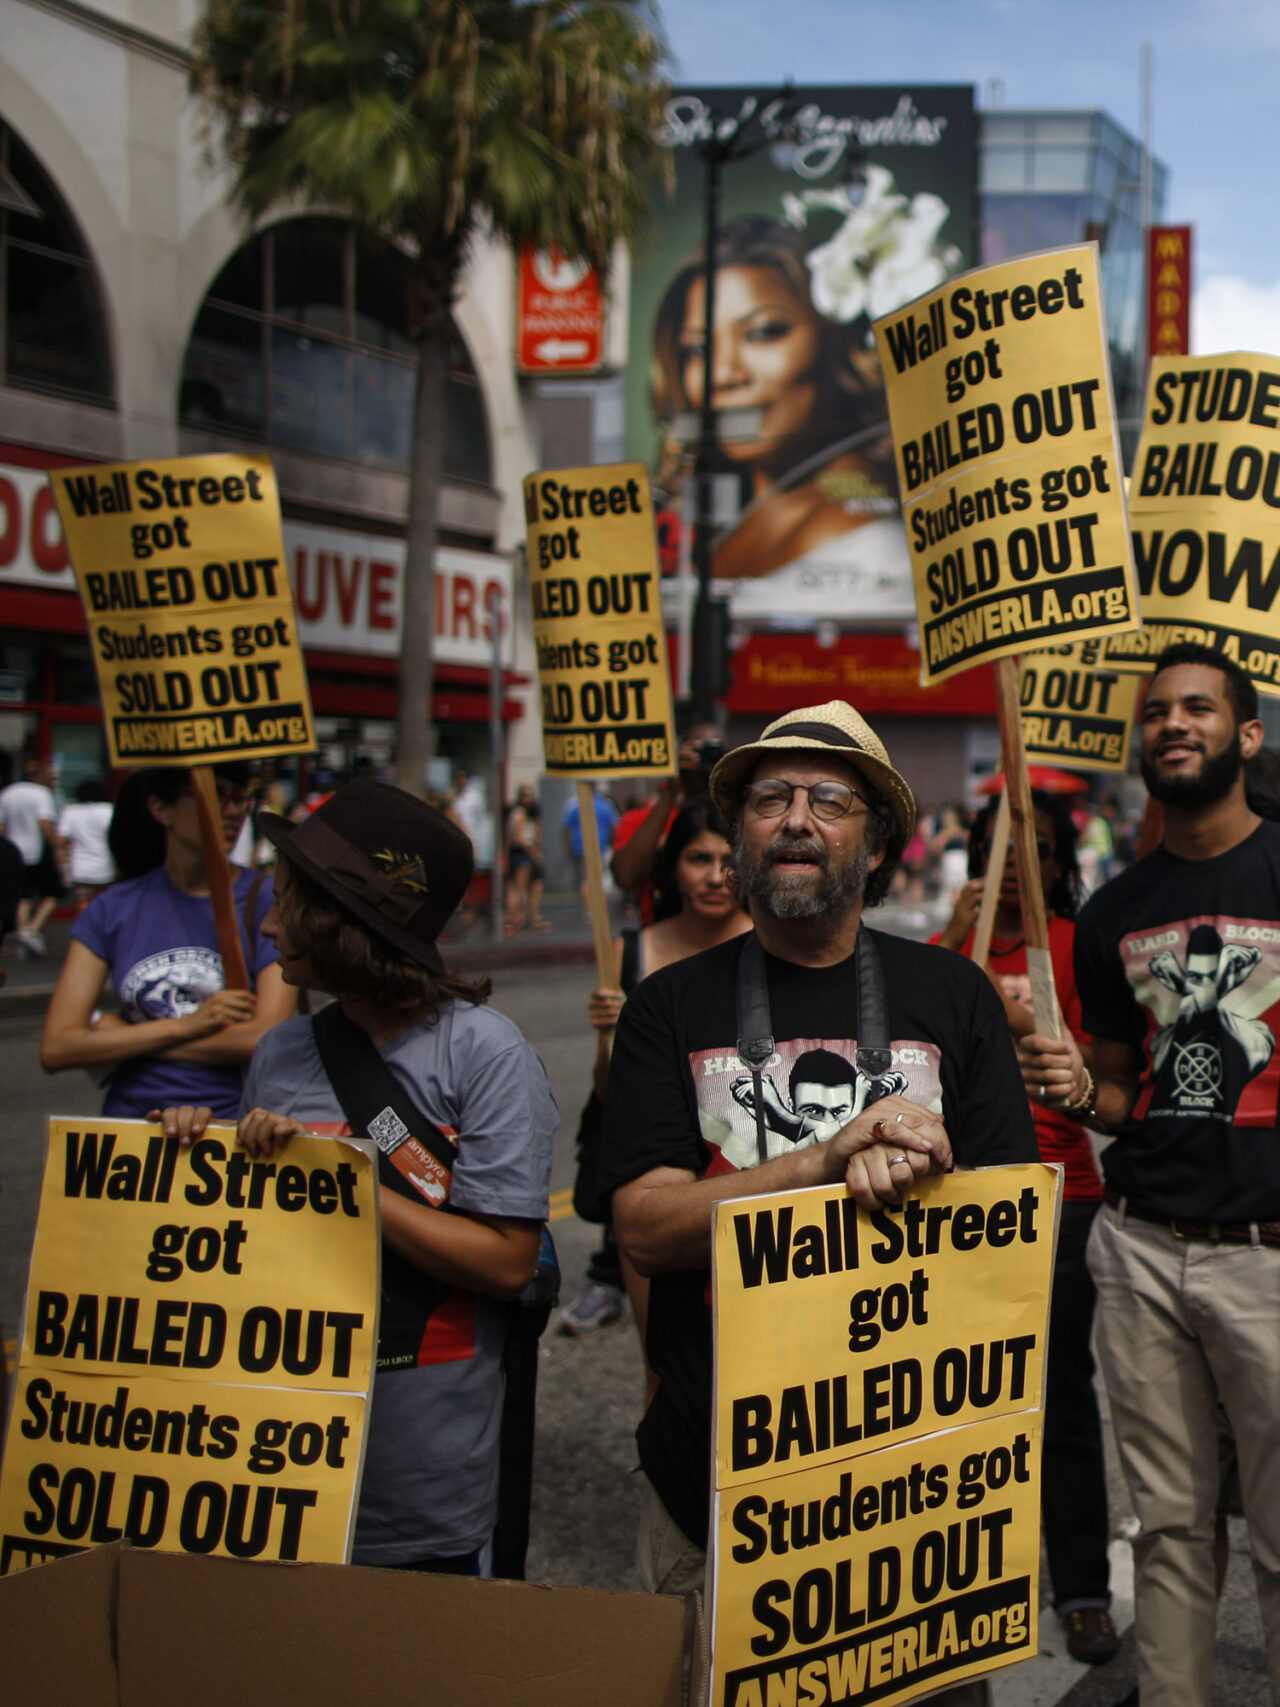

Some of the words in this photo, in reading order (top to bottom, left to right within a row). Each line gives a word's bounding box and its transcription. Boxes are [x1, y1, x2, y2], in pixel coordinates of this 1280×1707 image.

[885, 298, 948, 373] Wall
[953, 267, 1084, 340] Street
[945, 338, 1002, 402] got
[902, 401, 1005, 491] BAILED
[1013, 378, 1099, 444] OUT
[64, 472, 133, 517] Wall
[135, 469, 263, 511] Street
[541, 478, 642, 521] Street
[911, 476, 1031, 552] Students
[1041, 455, 1110, 511] got
[131, 515, 191, 559] got
[538, 525, 580, 569] got
[926, 537, 999, 614] SOLD
[1007, 513, 1099, 581] OUT
[86, 567, 195, 611] BAILED
[202, 558, 278, 602] OUT
[587, 572, 651, 615] OUT
[97, 622, 223, 661] Students
[231, 617, 290, 657] got
[608, 634, 658, 672] got
[929, 585, 1127, 666] ANSWERLA.org
[115, 670, 193, 713] SOLD
[201, 662, 281, 707] OUT
[581, 679, 649, 722] OUT
[1043, 668, 1118, 714] OUT
[118, 714, 306, 752] ANSWERLA.org
[1127, 930, 1180, 953] HARD
[704, 1053, 782, 1076] HAD
[64, 1132, 180, 1203] Wall
[184, 1139, 360, 1218] Street
[407, 1140, 445, 1177] ampyra
[146, 1220, 247, 1282] got
[733, 1196, 860, 1289] Wall
[870, 1186, 1039, 1265] Street
[34, 1291, 228, 1369] BAILED
[238, 1305, 364, 1378] OUT
[847, 1268, 929, 1353] got
[21, 1378, 240, 1459] Students
[247, 1415, 350, 1475] got
[732, 1358, 922, 1472] BAILED
[933, 1333, 1036, 1421] OUT
[23, 1462, 170, 1549] SOLD
[179, 1480, 318, 1561] OUT
[732, 1464, 948, 1564] Students
[958, 1433, 1030, 1510] got
[750, 1545, 900, 1658] SOLD
[912, 1508, 1012, 1605] OUT
[733, 1601, 1028, 1707] ANSWERLA.org
